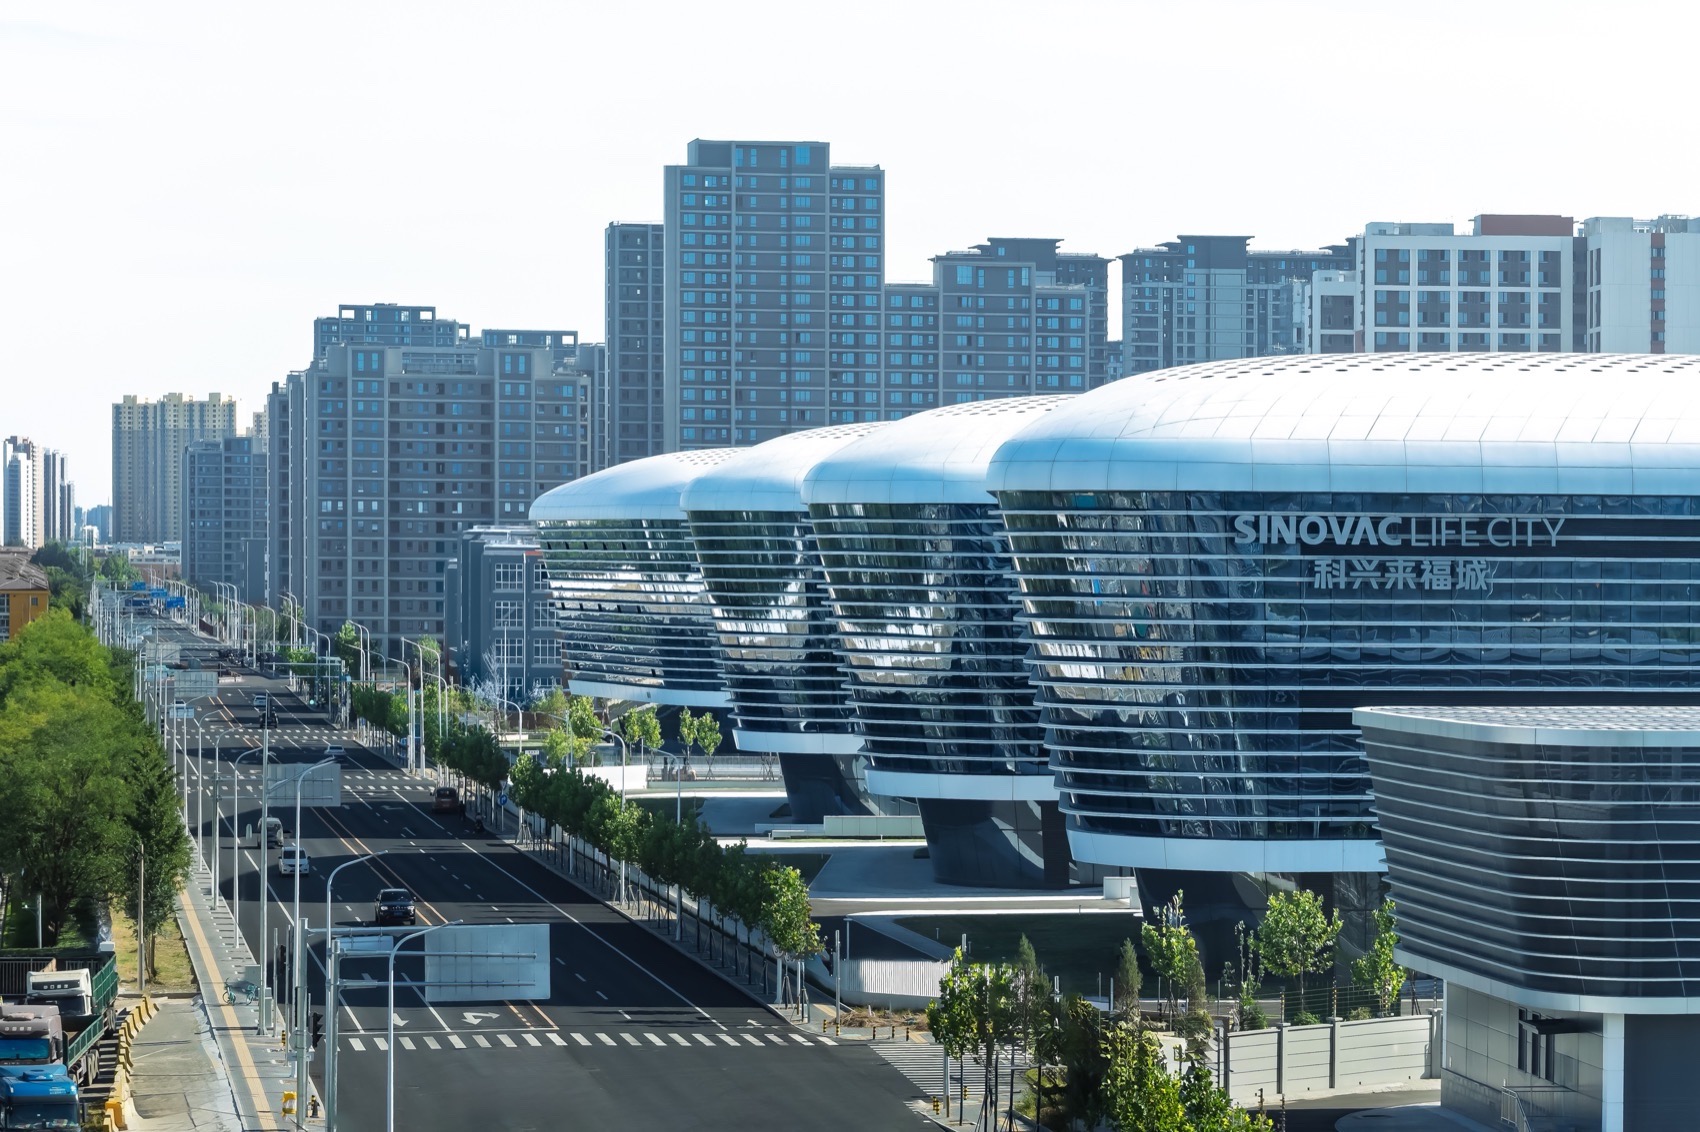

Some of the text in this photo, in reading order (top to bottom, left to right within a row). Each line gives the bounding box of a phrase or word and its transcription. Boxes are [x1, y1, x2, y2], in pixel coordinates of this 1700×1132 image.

[1234, 515, 1566, 547] SINOVAC LIFE CITY
[1314, 558, 1488, 591] 科兴来福城
